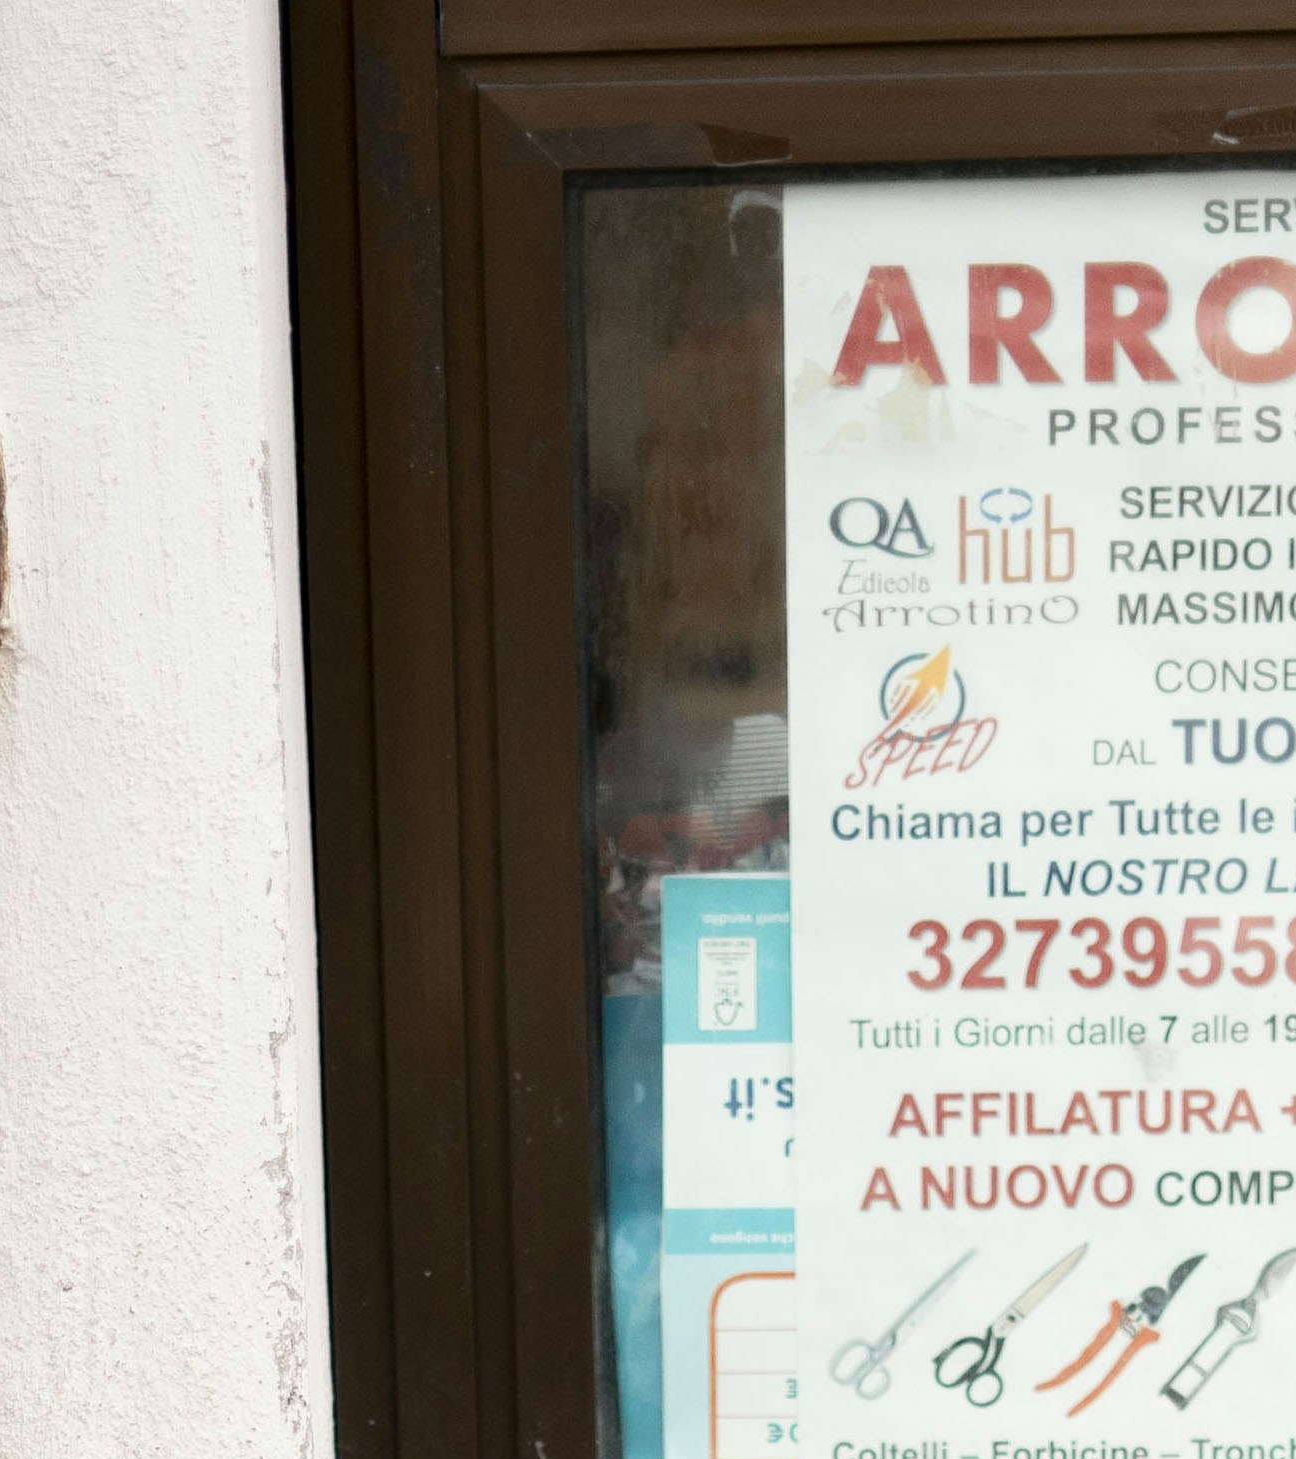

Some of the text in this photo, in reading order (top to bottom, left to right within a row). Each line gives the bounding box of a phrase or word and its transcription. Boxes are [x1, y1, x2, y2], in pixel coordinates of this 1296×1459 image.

[830, 494, 1075, 584] QA hub
[1109, 538, 1272, 573] RAPIDO
[838, 559, 931, 595] Edicola
[844, 717, 998, 789] SPEED
[1093, 739, 1155, 766] DAL
[1172, 718, 1296, 765] TUO
[831, 801, 1002, 842] Chiama
[1019, 805, 1093, 849] per
[1108, 800, 1222, 837] Tutte
[1238, 797, 1276, 835] le
[987, 860, 1026, 899] IL
[1042, 857, 1248, 899] NOSTRO
[889, 1087, 1262, 1138] AFFILATURA
[861, 1167, 902, 1212] A
[921, 1164, 1134, 1212] NUOVO
